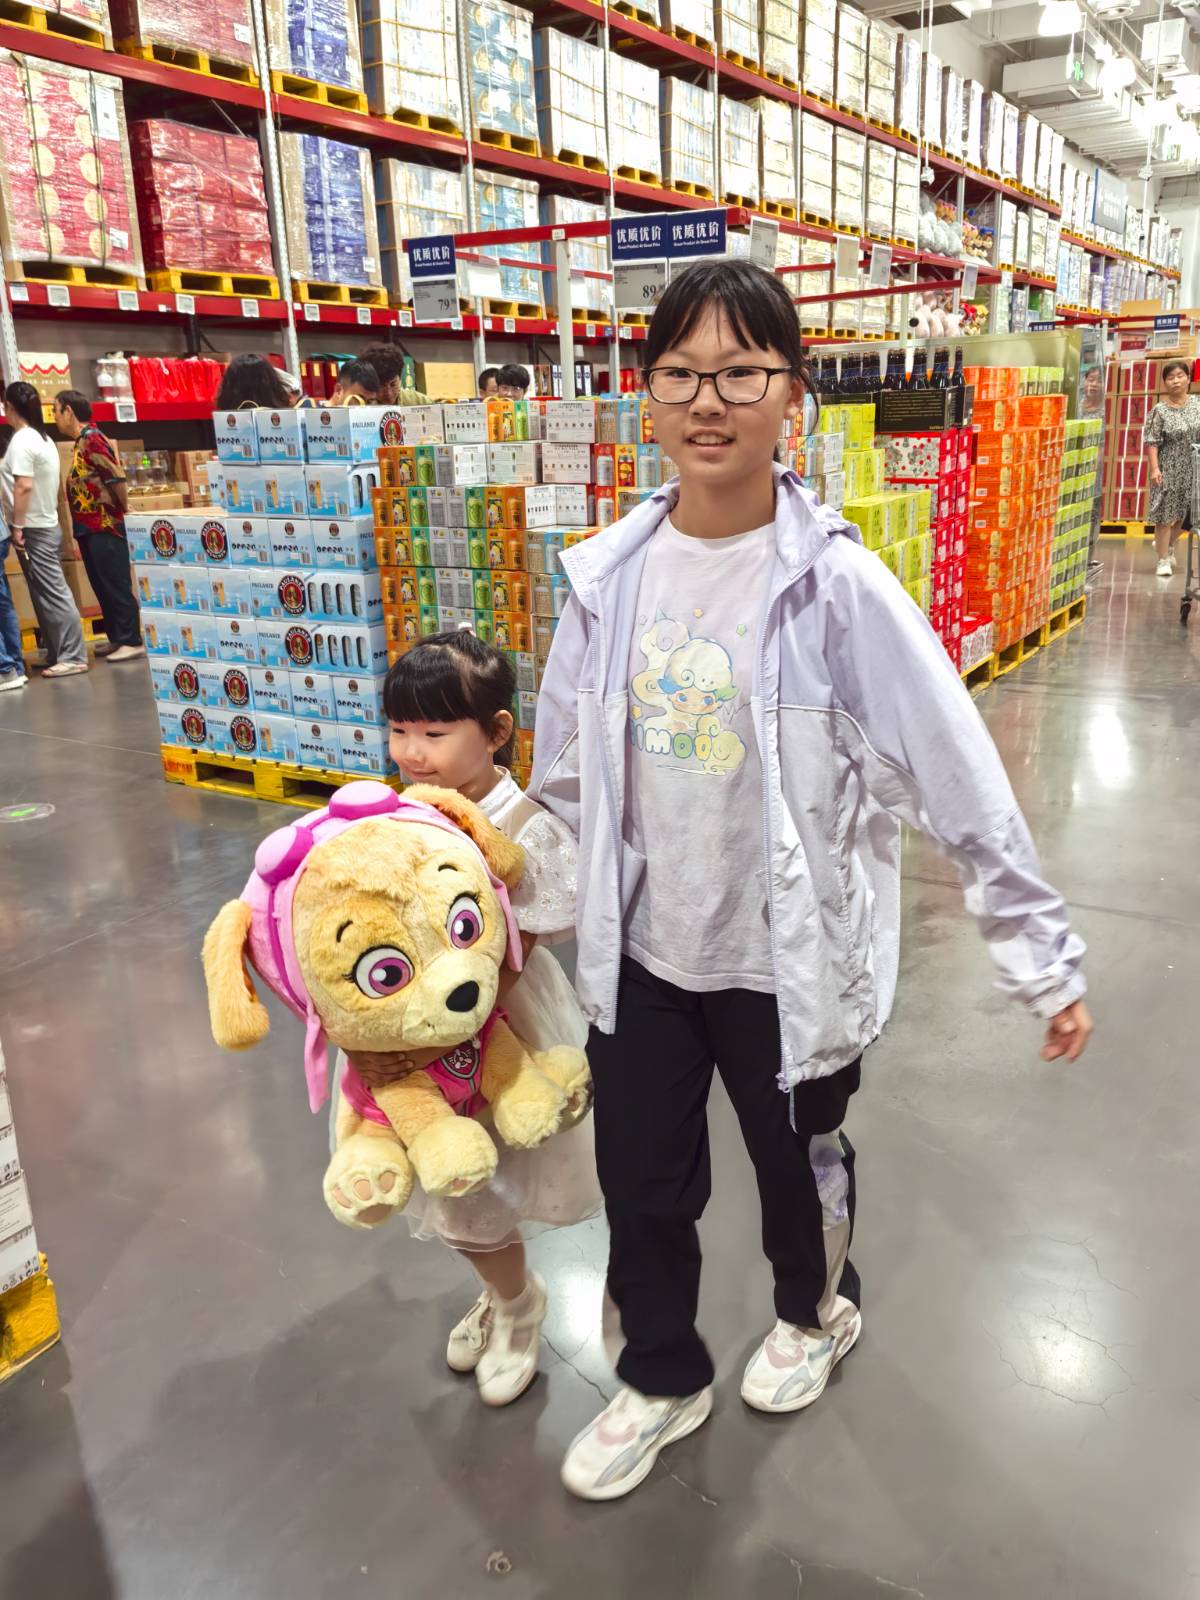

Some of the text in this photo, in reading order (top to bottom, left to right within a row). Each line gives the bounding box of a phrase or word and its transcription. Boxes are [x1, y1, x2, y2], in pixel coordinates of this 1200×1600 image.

[616, 225, 662, 244] 优质优价
[672, 221, 719, 241] 优质优价
[413, 246, 450, 262] 优质优价
[642, 285, 657, 298] 89
[438, 298, 450, 311] 79
